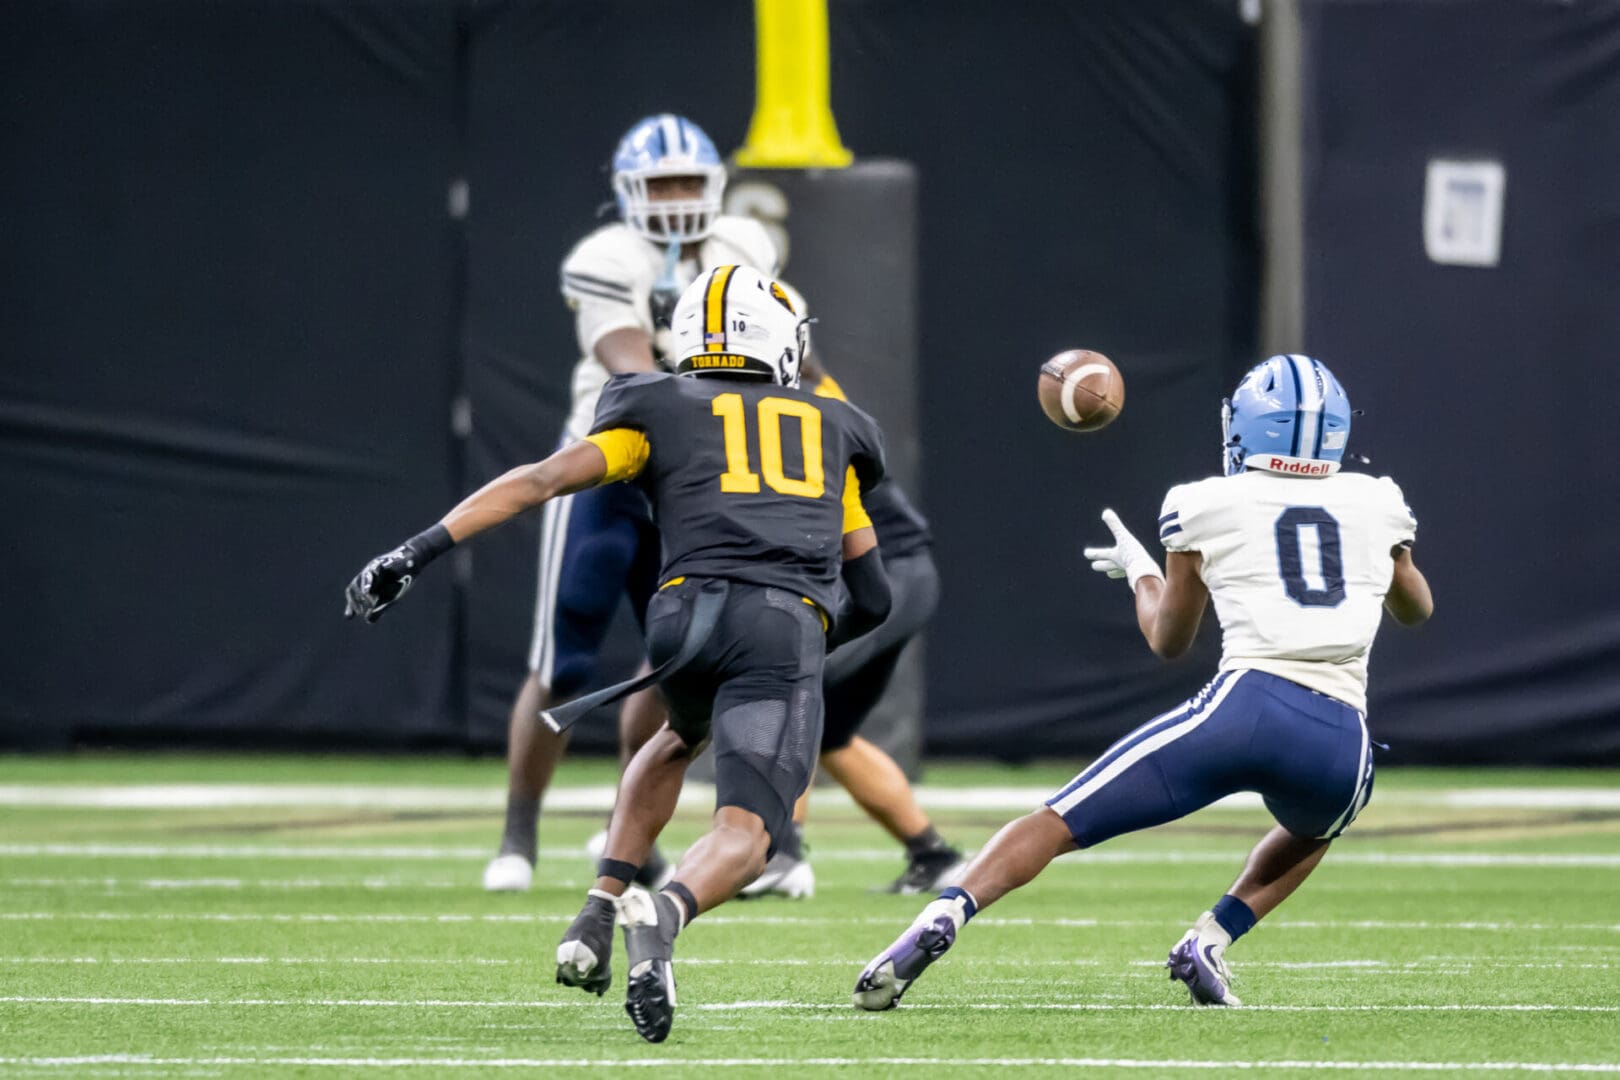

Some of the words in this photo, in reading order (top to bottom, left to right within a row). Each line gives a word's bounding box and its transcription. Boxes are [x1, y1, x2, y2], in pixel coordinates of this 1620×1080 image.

[732, 320, 746, 332] 10
[691, 356, 745, 368] TORNADO
[711, 392, 825, 499] 10
[1269, 458, 1329, 475] Riddell
[1274, 505, 1347, 609] 0
